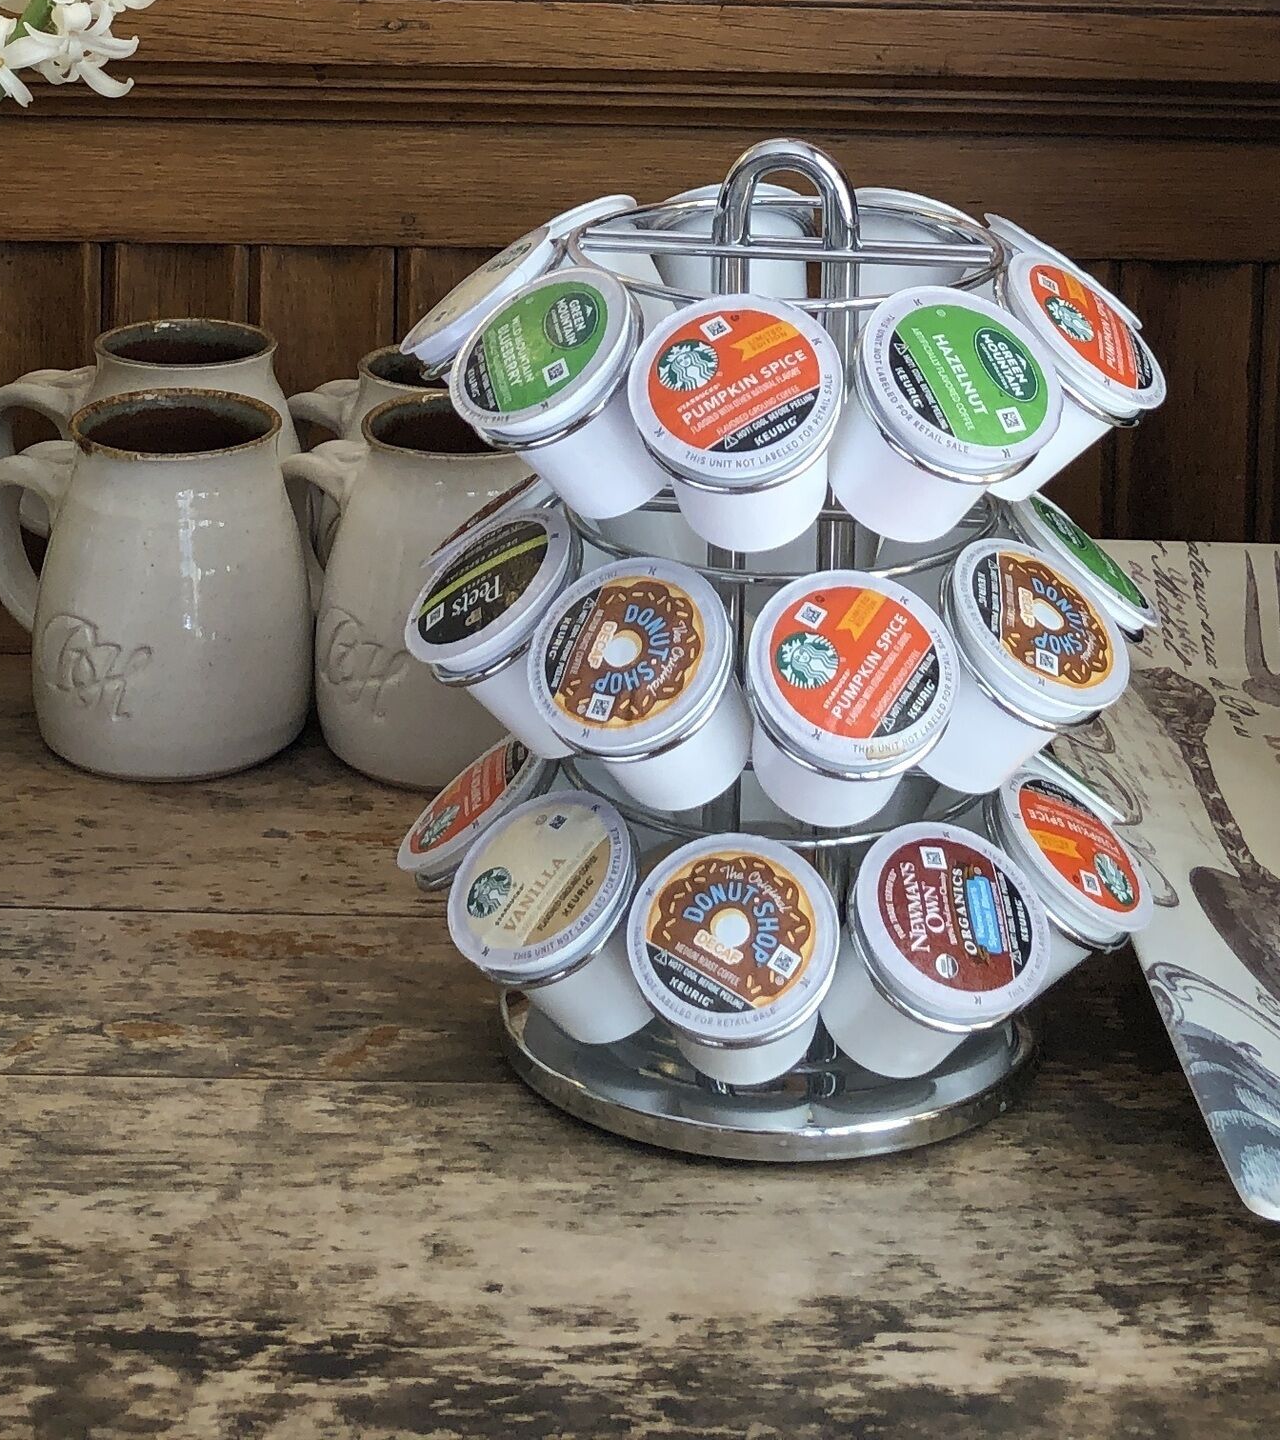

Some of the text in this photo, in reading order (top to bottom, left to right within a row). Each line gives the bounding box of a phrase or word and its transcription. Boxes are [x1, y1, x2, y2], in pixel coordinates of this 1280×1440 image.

[555, 298, 577, 346] MOUNTAIN
[569, 299, 586, 331] GREEN
[497, 324, 522, 386] BLUEBERRY
[932, 333, 989, 415] HAZELNUT
[981, 333, 1024, 397] MOUNTAIN
[997, 342, 1028, 385] GREEN
[681, 349, 808, 426] PUMPKIN SPICE
[875, 365, 898, 403] LABELED
[896, 404, 912, 421] FOR
[913, 420, 943, 444] RETAIL
[946, 440, 969, 454] SALE
[685, 452, 706, 465] THIS
[709, 459, 732, 468] UNIT
[735, 459, 755, 468] NOT
[759, 440, 798, 465] LABELED
[800, 424, 815, 444] FOR
[824, 373, 833, 394] SALE
[753, 415, 770, 432] COOL
[790, 393, 815, 410] PEELING
[754, 416, 798, 446] KEURIG
[594, 604, 671, 694] DONUT SHOP
[831, 650, 882, 720] PUMPKIN
[876, 612, 908, 651] SPICE
[1035, 632, 1083, 655] SHOP
[853, 745, 875, 754] THIS
[878, 740, 900, 752] UNIT
[943, 684, 952, 701] FOR
[907, 679, 936, 720] KEURIG
[1028, 808, 1065, 829] SPICE
[504, 858, 567, 930] VANILLA
[562, 876, 595, 917] KEURIG
[720, 865, 792, 914] The Original
[900, 861, 930, 953] NEWMAN'S
[923, 885, 945, 934] OWN
[952, 868, 978, 956] ORGANICS
[513, 950, 532, 960] THIS
[535, 944, 554, 957] UNIT
[557, 930, 574, 947] NOT
[603, 876, 614, 897] FOR
[683, 882, 780, 963] DONUT SHOP
[696, 933, 743, 963] DECAF
[700, 954, 717, 973] ROAST
[717, 966, 740, 988] COFFEE
[669, 977, 714, 1007] KEURIG
[683, 965, 698, 981] COOL
[719, 987, 745, 1010] PEELING
[694, 1016, 713, 1025] FOR
[717, 1016, 752, 1026] RETAIL
